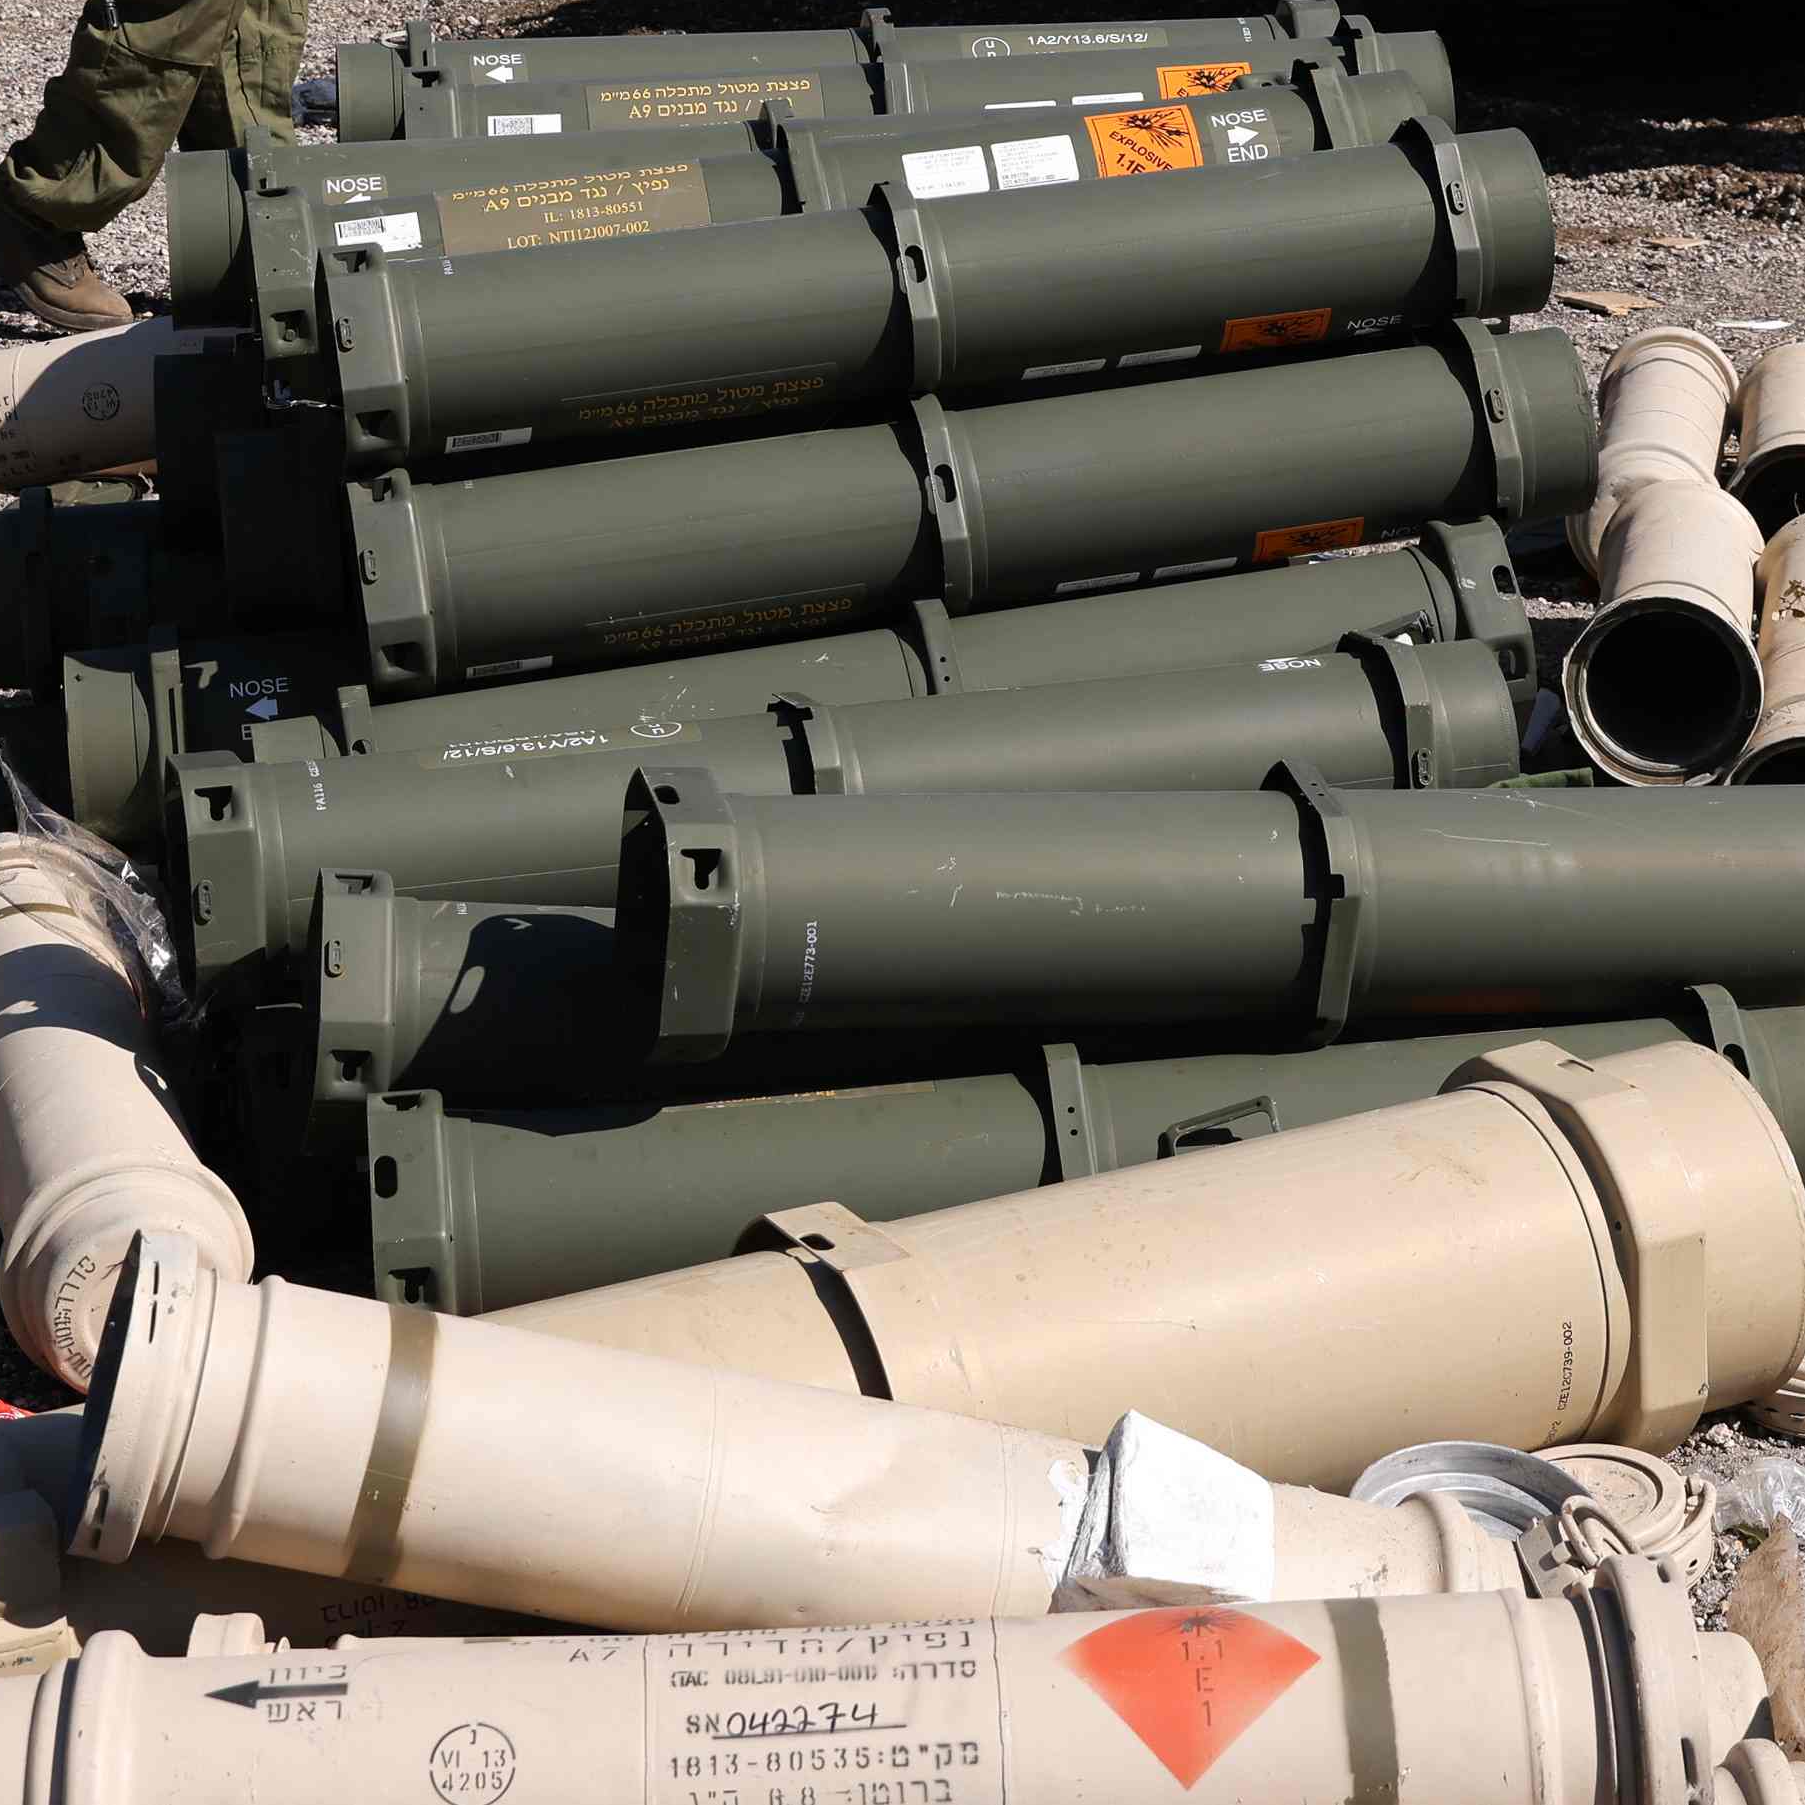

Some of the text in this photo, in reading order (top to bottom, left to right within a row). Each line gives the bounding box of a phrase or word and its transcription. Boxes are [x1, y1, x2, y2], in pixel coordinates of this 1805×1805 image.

[1027, 33, 1149, 46] 1A2/Y13.6/S/12/
[472, 54, 523, 66] NOSE
[655, 86, 713, 99] מתכלה
[717, 82, 761, 95] מטול
[766, 78, 812, 92] פצצת
[657, 102, 707, 118] מבנים
[713, 100, 738, 114] נגד
[1210, 109, 1268, 128] NOSE
[1227, 144, 1269, 163] END
[583, 170, 632, 184] מטול
[639, 163, 689, 177] פצצת
[326, 176, 383, 194] NOSE
[514, 177, 578, 192] מתכלה
[580, 186, 608, 199] נגד
[631, 178, 670, 195] נפיץ
[485, 198, 511, 213] A9
[517, 190, 573, 208] מבנים
[543, 202, 645, 224] IL: 1813-80551
[507, 234, 542, 250] LOT:
[1347, 314, 1404, 331] NOSE
[229, 677, 290, 699] NOSE
[268, 1664, 348, 1685] כיוון
[1195, 1667, 1215, 1693] E
[266, 1699, 343, 1724] ראש
[685, 1701, 879, 1738] SN 042274
[1202, 1699, 1212, 1727] 1
[484, 1748, 507, 1769] 13
[441, 1770, 504, 1793] 4205
